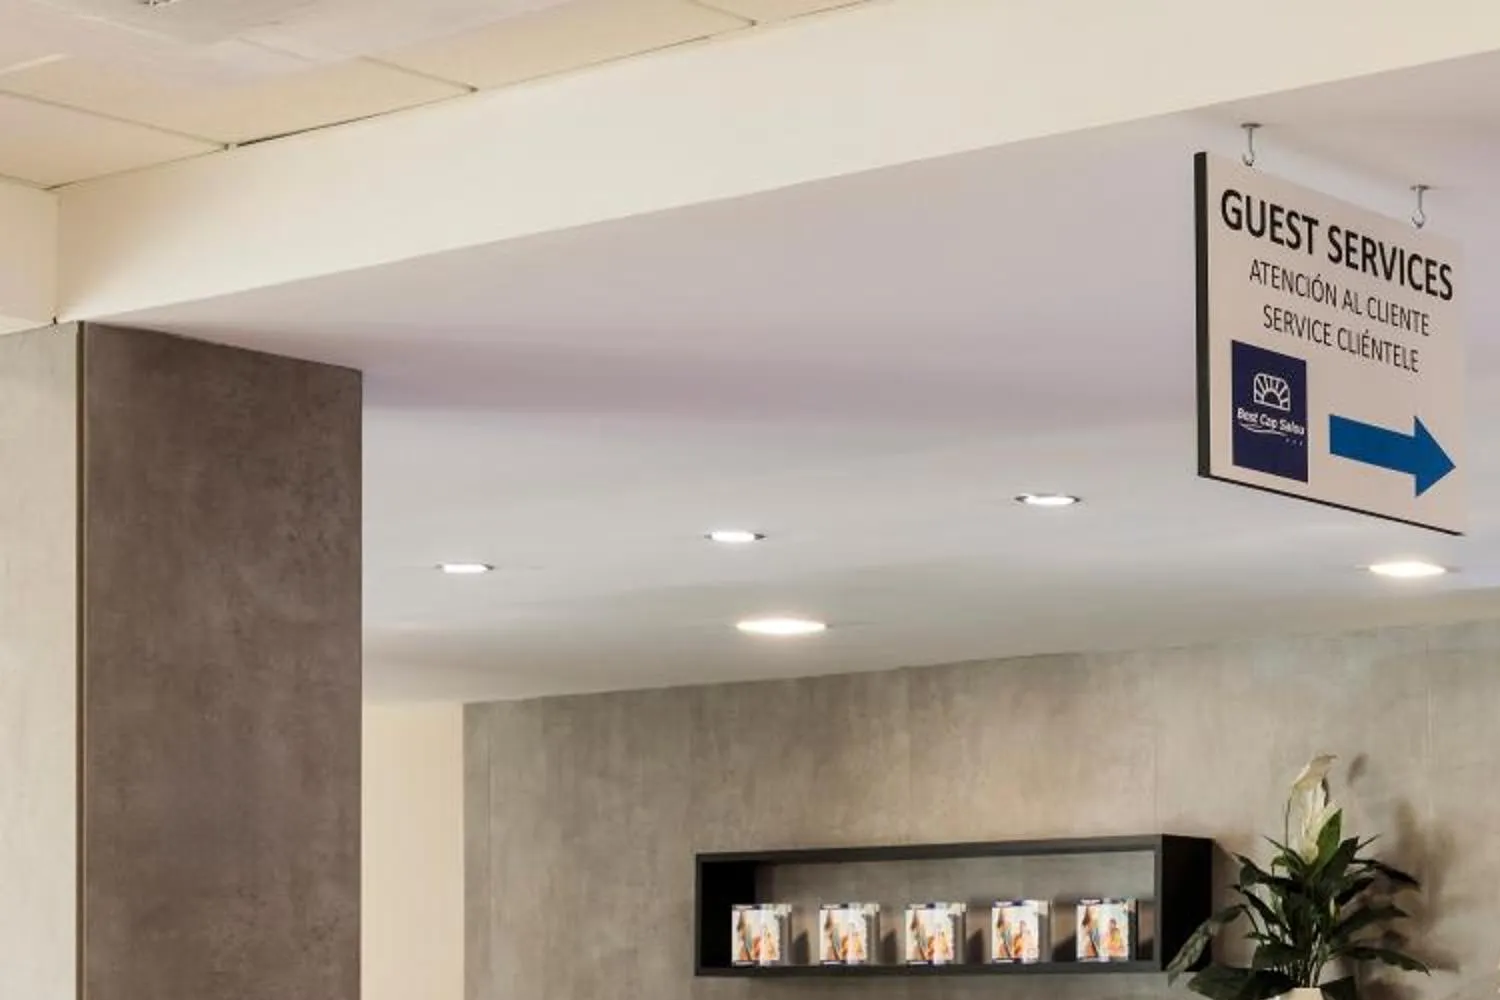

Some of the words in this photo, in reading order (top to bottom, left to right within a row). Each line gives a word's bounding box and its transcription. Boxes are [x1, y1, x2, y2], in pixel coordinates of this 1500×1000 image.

[1221, 189, 1319, 255] GUEST
[1327, 225, 1453, 301] SERVICES
[1250, 259, 1337, 308] ATENCIÓN
[1342, 290, 1363, 316] AL
[1367, 297, 1429, 337] CLIENTE
[1263, 304, 1332, 347] SERVICE
[1337, 327, 1419, 373] CLIÉNTELE
[1237, 407, 1258, 423] Best
[1260, 413, 1278, 430] Cap
